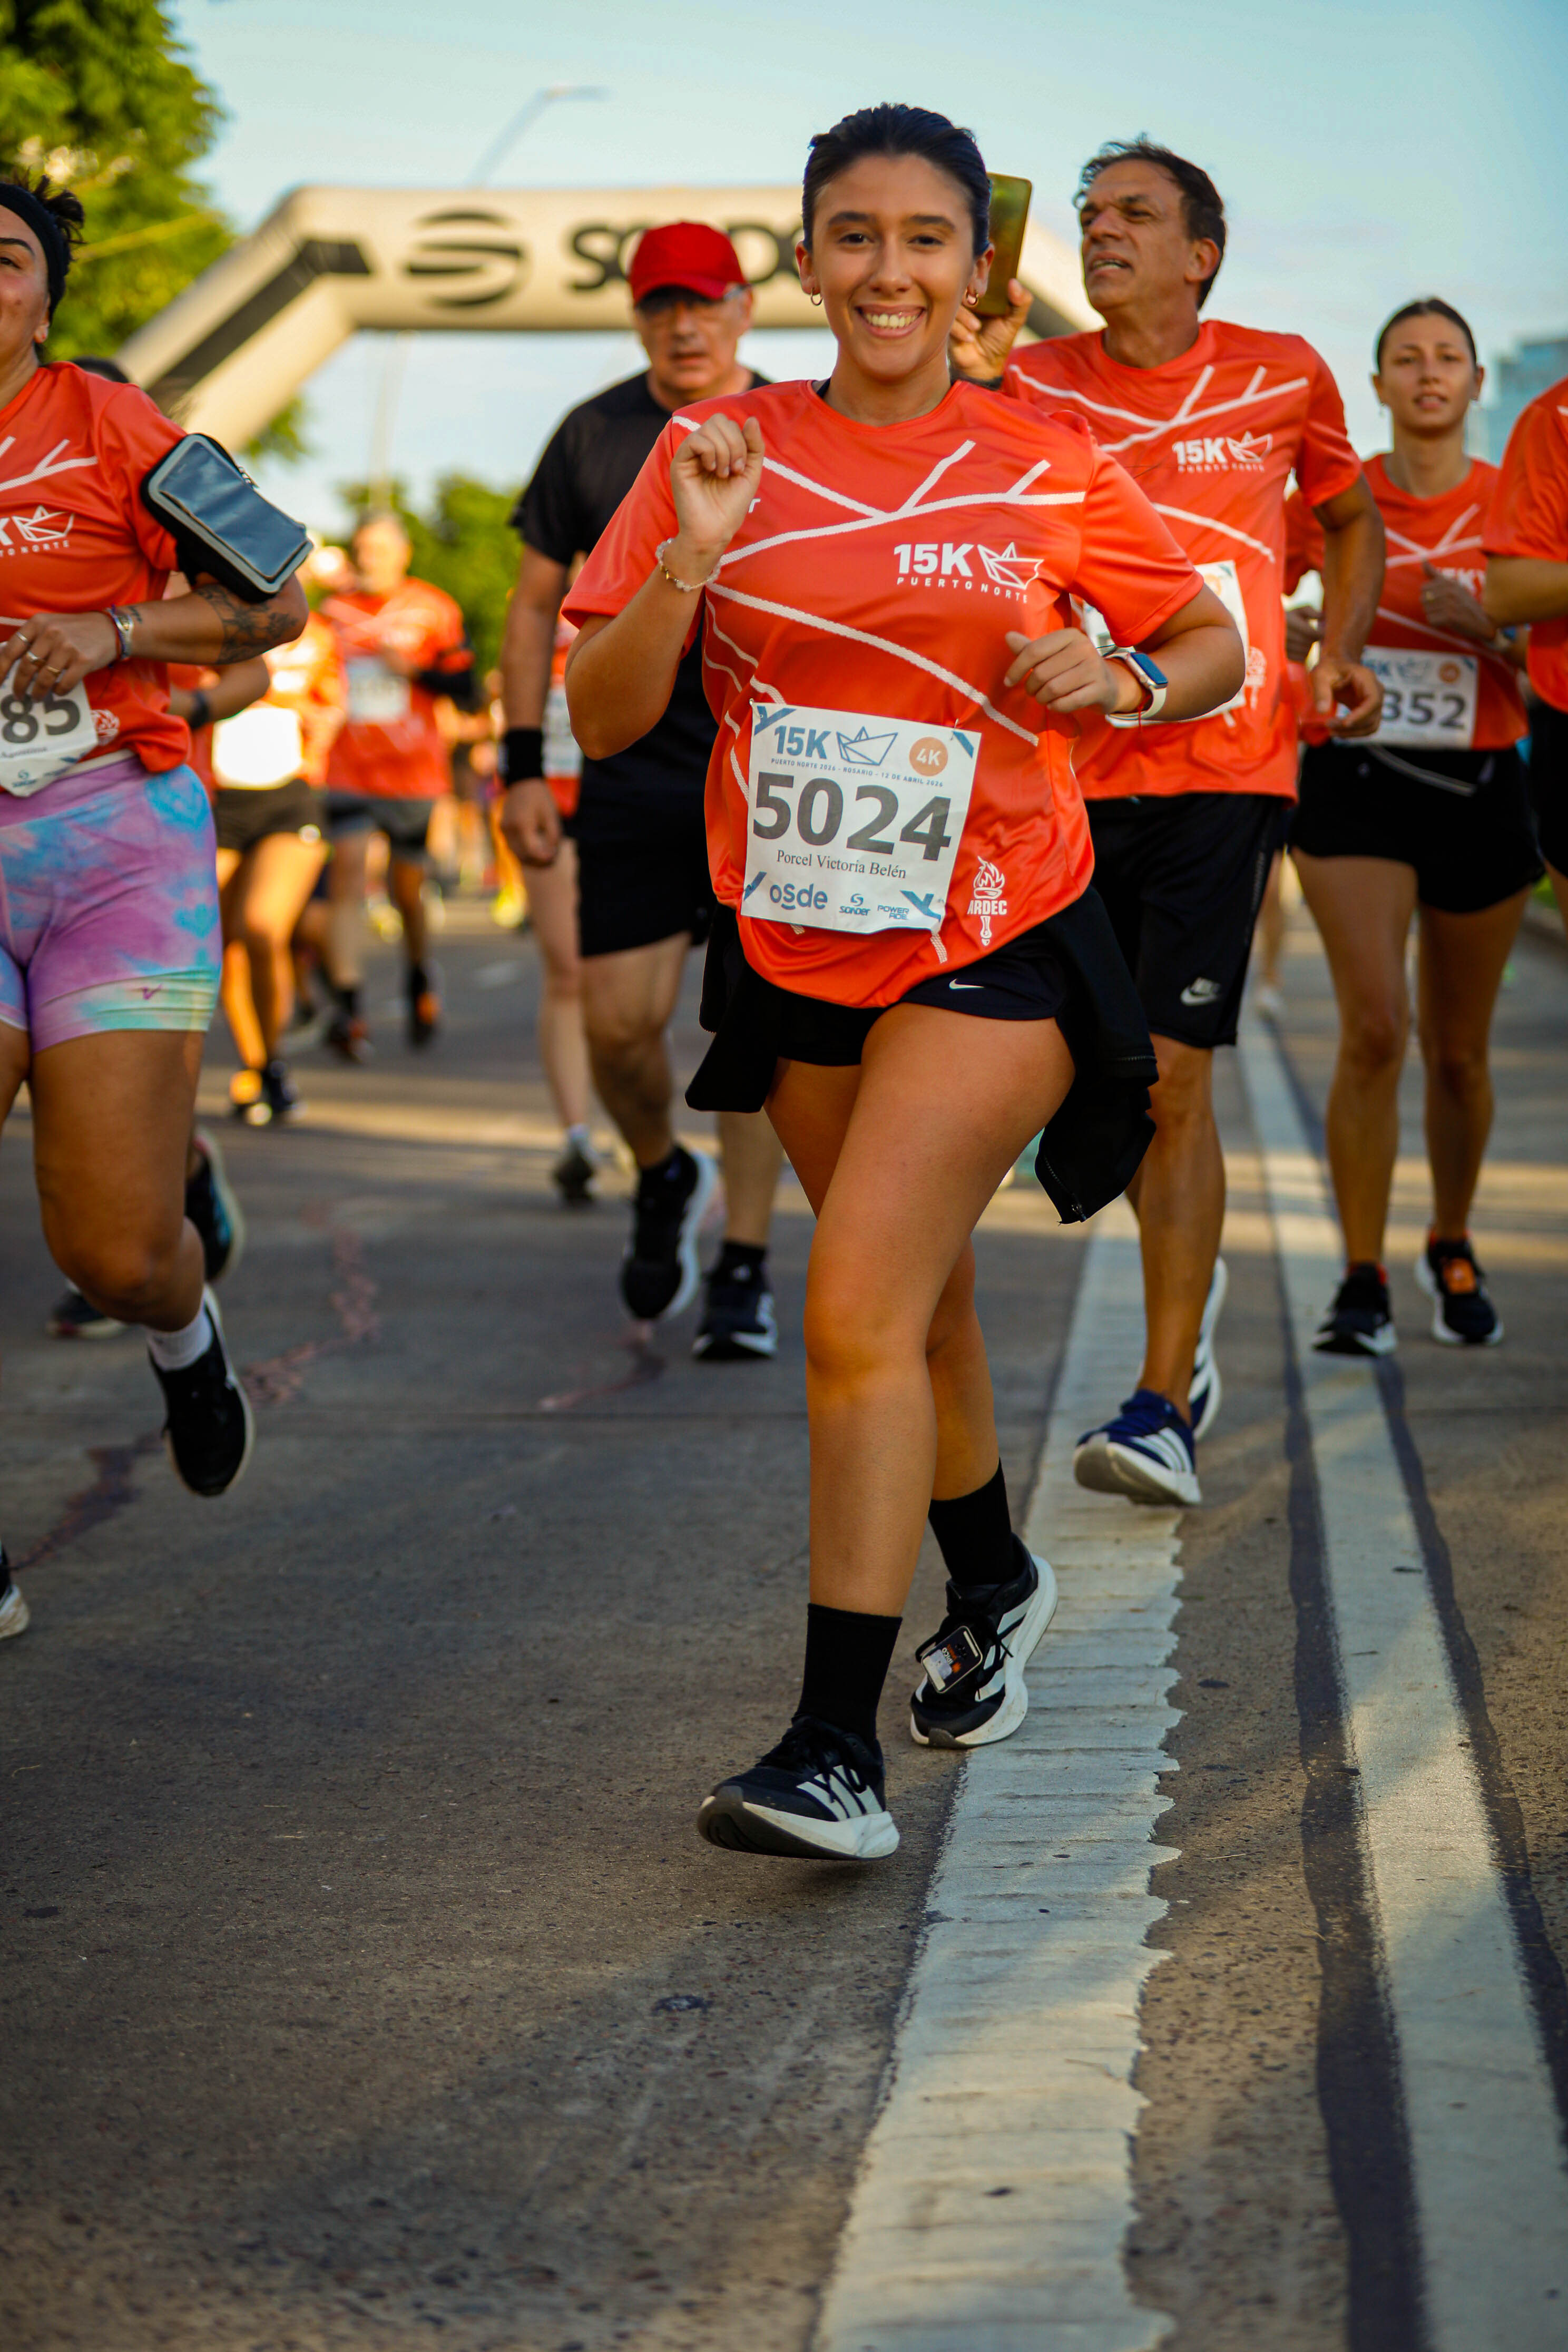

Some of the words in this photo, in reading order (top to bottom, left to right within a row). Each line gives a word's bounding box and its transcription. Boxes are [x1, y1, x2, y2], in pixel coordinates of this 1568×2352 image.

[1172, 437, 1228, 465] 15K
[21, 540, 70, 554] NORTE
[894, 543, 974, 577] 15K
[897, 577, 972, 590] PUERTO
[981, 583, 1027, 604] NORTE
[775, 725, 831, 759] 15K
[771, 758, 795, 766] PUERTO
[842, 767, 873, 776] ROSARIO
[916, 748, 941, 766] 4K
[753, 771, 952, 861] 5024
[777, 849, 812, 866] Porcel
[817, 855, 865, 873] Victoria
[869, 861, 906, 879] Belén
[770, 883, 828, 909] osde
[967, 900, 1007, 915] ARDEC
